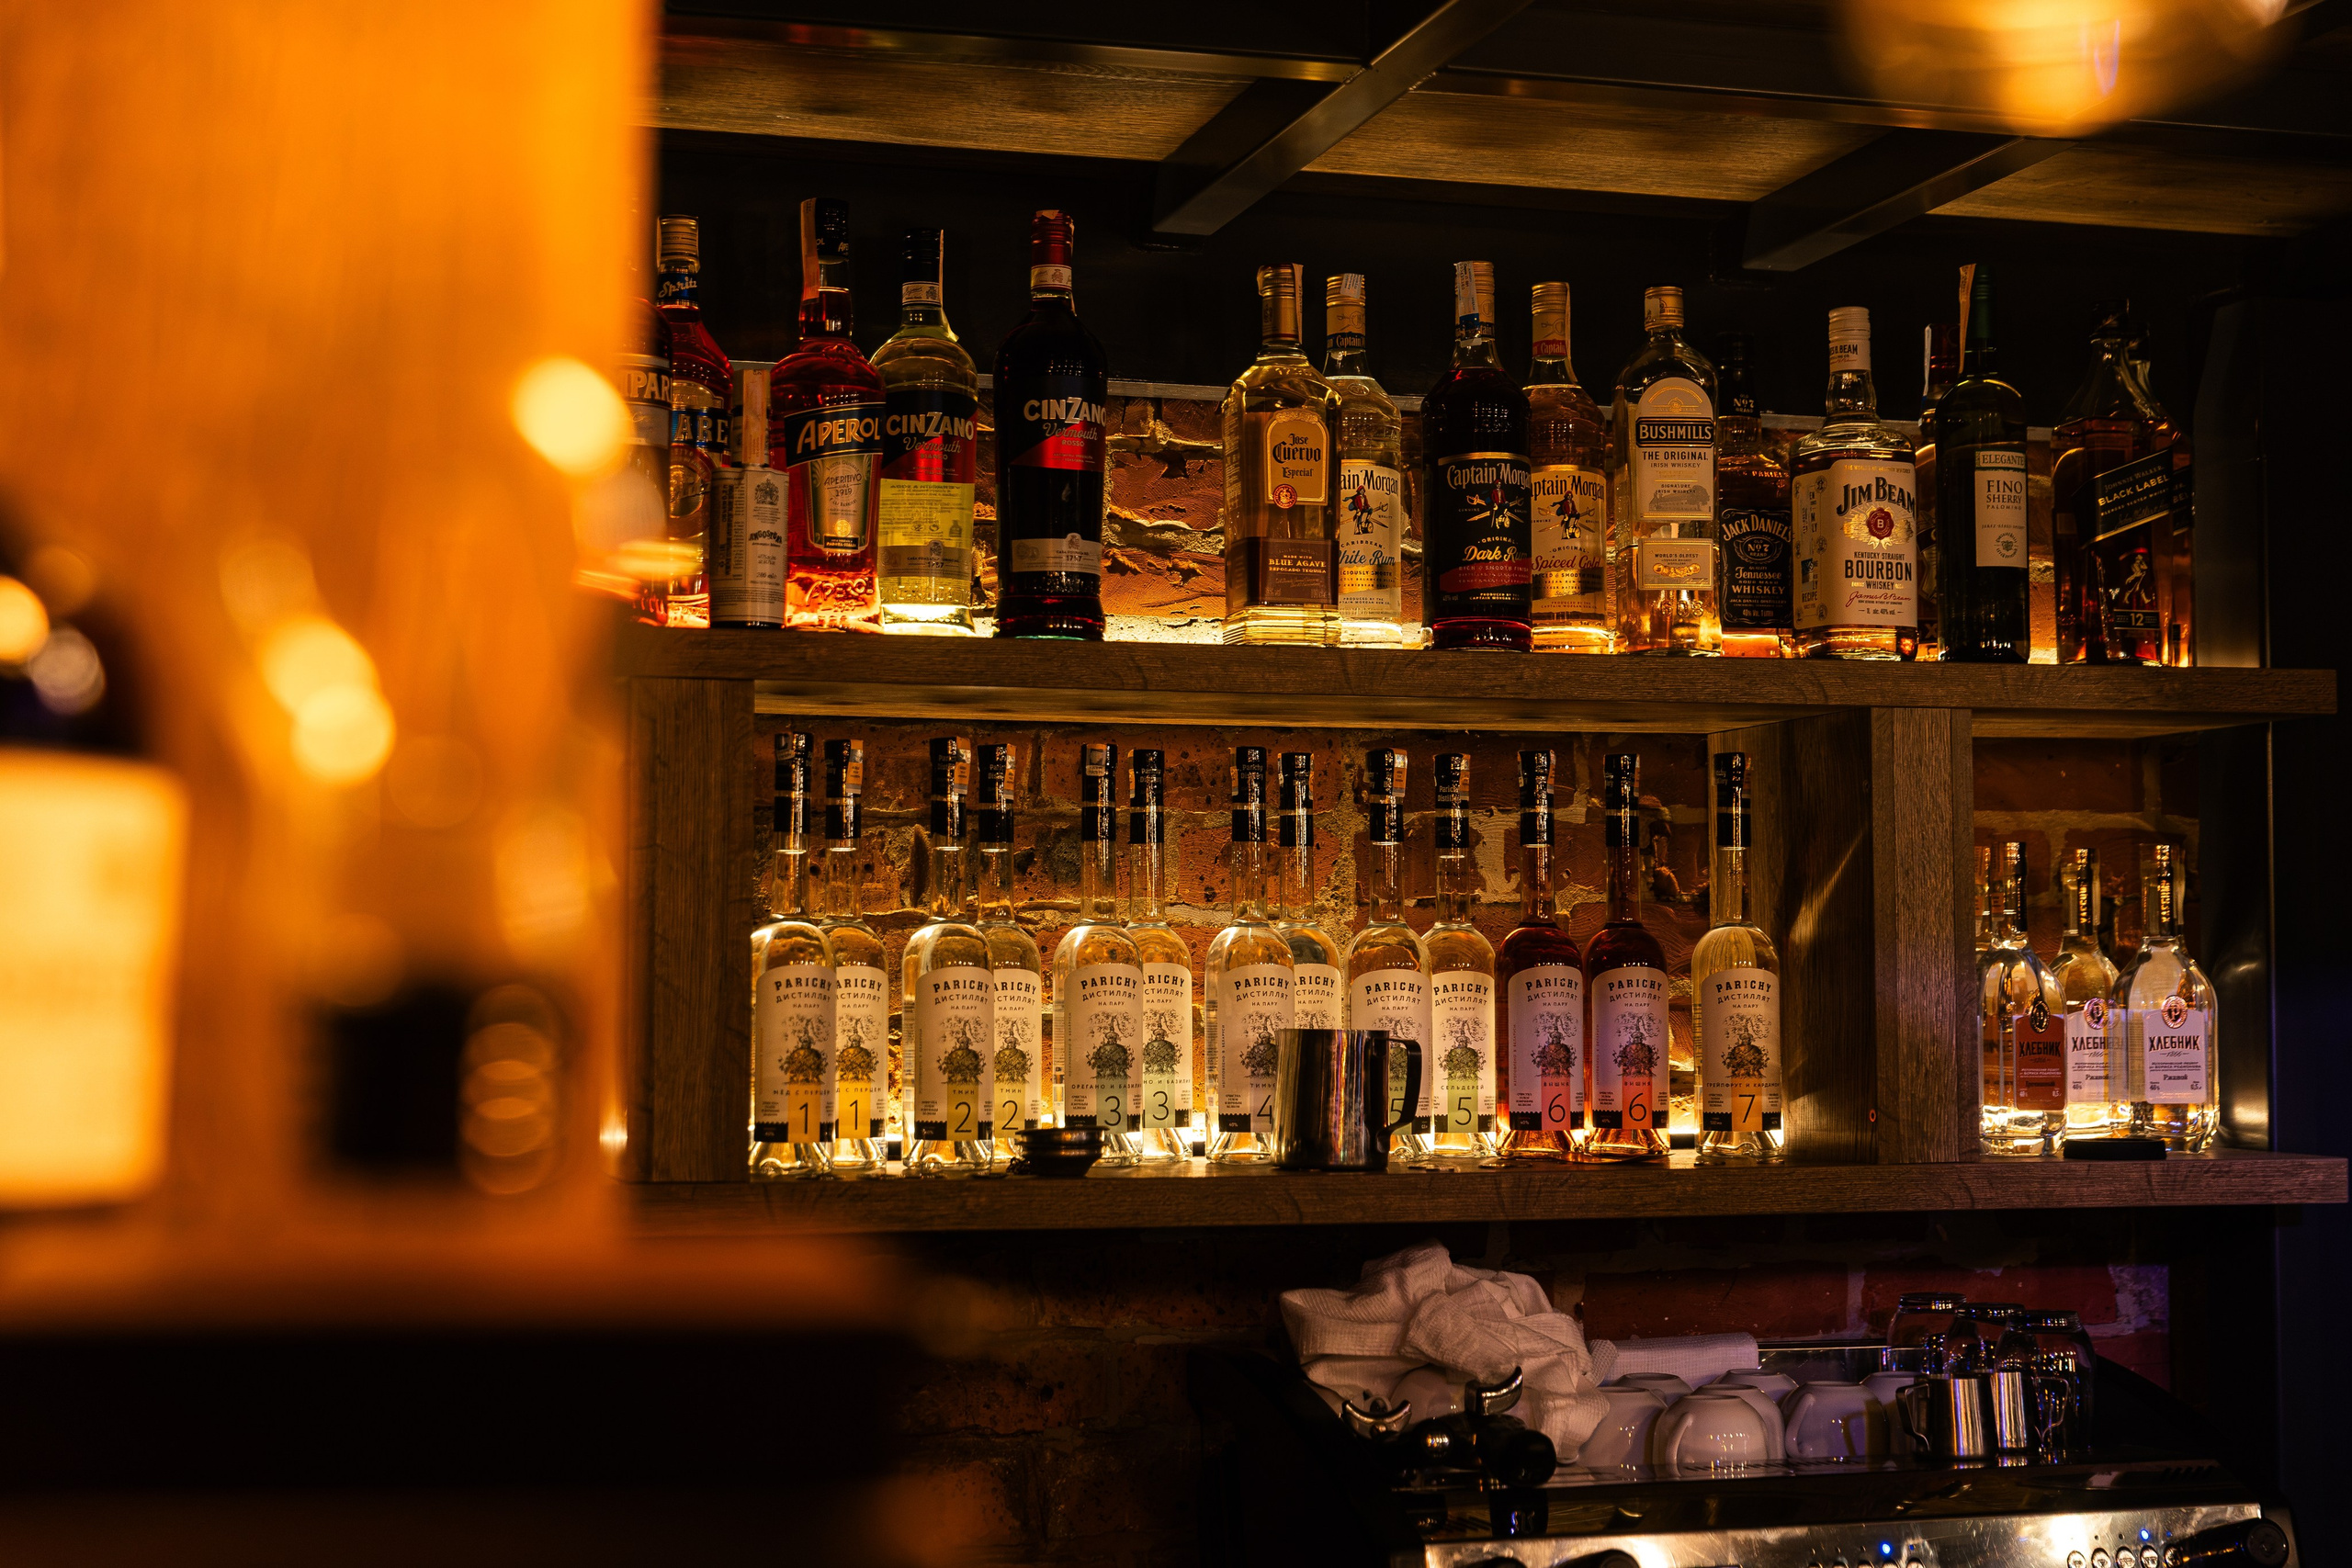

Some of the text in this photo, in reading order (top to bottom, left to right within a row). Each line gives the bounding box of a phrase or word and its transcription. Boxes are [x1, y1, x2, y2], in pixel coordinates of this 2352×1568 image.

[1336, 335, 1363, 348] Captain
[1023, 396, 1107, 426] CINZANO
[886, 412, 974, 440] CINZANO
[1043, 423, 1098, 440] Vermouth
[1639, 424, 1712, 439] BUSHMILLS
[797, 417, 881, 454] APEROL
[1288, 434, 1308, 446] Jose
[903, 436, 961, 453] Vermouth
[1272, 441, 1321, 464] Cuervo
[1642, 451, 1708, 460] THE ORIGINAL
[1982, 454, 2024, 467] ELEGANTE
[824, 473, 862, 486] APERITIVO
[1282, 467, 1314, 479] Especial
[1447, 462, 1497, 490] Captain
[2104, 466, 2164, 493] JOHNNIE WALKER
[835, 488, 853, 497] 1919
[1532, 475, 1566, 501] ptain
[1986, 479, 2023, 494] FINO
[2098, 474, 2169, 506] BLACK LABEL
[1837, 483, 1872, 516] JIM
[1875, 477, 1916, 519] BEAM
[1986, 493, 2022, 504] SHERRY
[1721, 517, 1750, 541] JACK
[1878, 519, 1884, 528] B
[1369, 550, 1395, 566] Rum
[1463, 546, 1527, 563] Dark Rum
[1854, 551, 1905, 560] KENTUCKY STRAIGHT
[1296, 559, 1326, 568] AGAVE
[1532, 555, 1601, 571] Spiced Gold
[1844, 559, 1912, 581] BOURBON
[1735, 567, 1782, 580] Tennessee
[1732, 585, 1785, 594] WHISKEY
[1865, 581, 1894, 590] WHISKEY
[1802, 591, 1818, 603] RECIPE
[2130, 613, 2143, 626] 12
[775, 976, 832, 991] PARICHY
[933, 979, 989, 993] PARICHY
[1080, 976, 1137, 989] PARICHY
[1144, 974, 1185, 987] RICHY
[1234, 976, 1290, 990] PARICHY
[1295, 976, 1335, 988] RICHY
[1525, 977, 1578, 991] PARICHY
[1608, 978, 1663, 992] PARICHY
[1716, 979, 1772, 993] PARICHY
[994, 981, 1036, 995] ARICHY
[1082, 989, 1136, 1001] ДИСТИЛЛЯТ
[1145, 987, 1184, 998] СТИЛЛЯТ
[1296, 988, 1334, 999] СТИЛЛЯТ
[1365, 981, 1422, 995] PARICHY
[1433, 982, 1489, 996] PARICHY
[775, 991, 831, 1003] ДИСТИЛЛЯТ
[836, 992, 881, 1003] СТИЛЛЯТ
[934, 994, 989, 1005] ДИСТИЛЛЯТ
[996, 995, 1035, 1006] СТИЛЛЯТ
[1236, 990, 1288, 1002] ДИСТИЛЛЯТ
[1367, 995, 1421, 1006] ДИСТИЛЛЯТ
[1434, 996, 1487, 1007] ДИСТИЛЛЯТ
[1527, 991, 1577, 1002] ДИСТИЛЛЯТ
[1610, 992, 1661, 1003] ДИСТИЛЛЯТ
[1717, 993, 1770, 1005] ДИСТИЛЛЯТ
[2018, 1041, 2062, 1057] ХЛЕБНИК
[2149, 1035, 2200, 1052] ХЛЕБНИК
[1104, 1096, 1122, 1126] 3
[1152, 1090, 1170, 1121] 3
[1257, 1095, 1272, 1124] 4
[1390, 1098, 1406, 1125] 5
[1455, 1097, 1472, 1125] 5
[1548, 1093, 1566, 1122] 6
[1629, 1093, 1646, 1122] 6
[1738, 1094, 1756, 1123] 7
[799, 1102, 808, 1134] 1
[850, 1100, 858, 1130] 1
[955, 1101, 972, 1133] 2
[1001, 1100, 1019, 1130] 2
